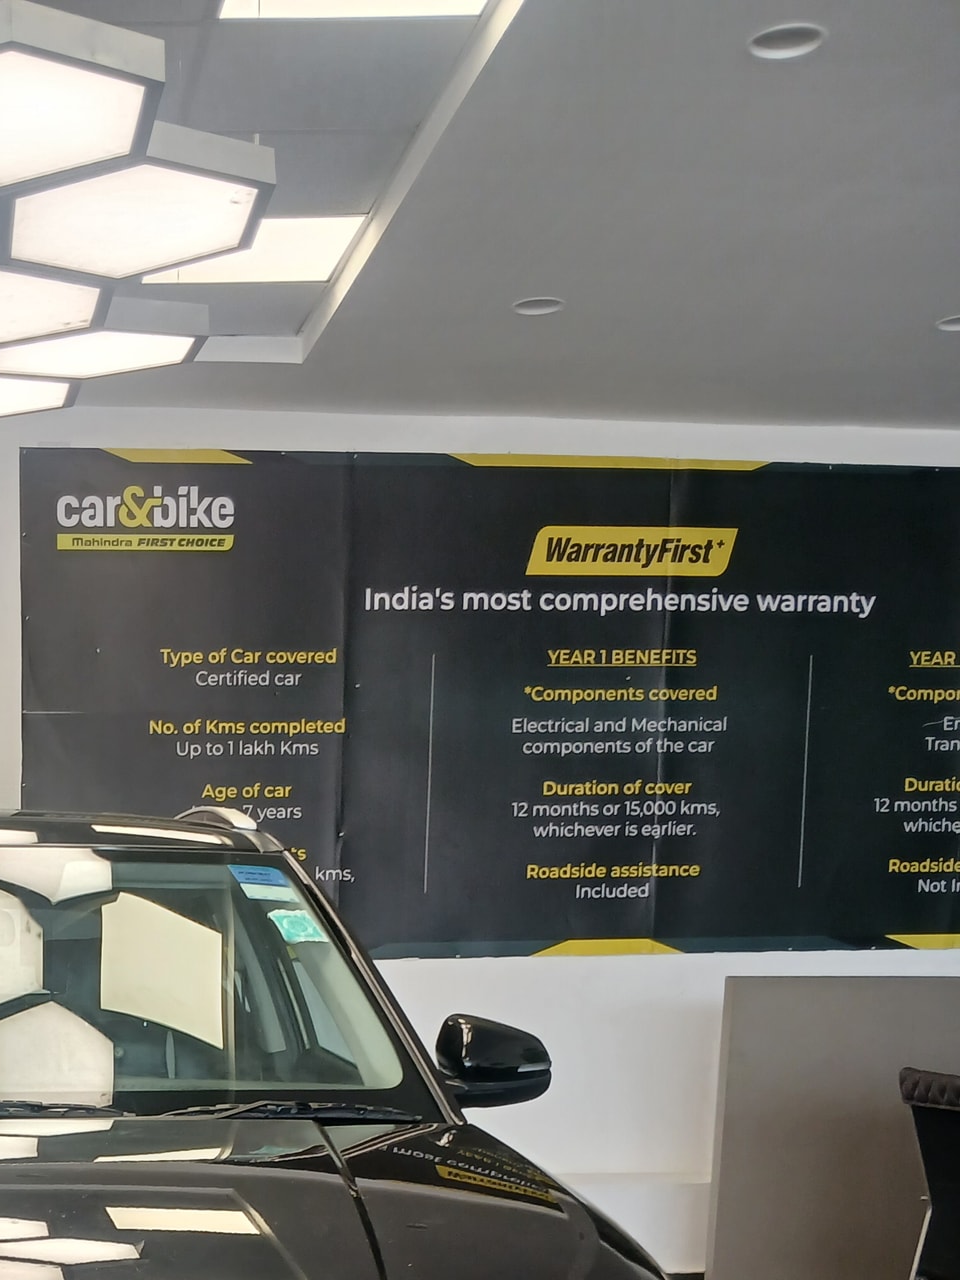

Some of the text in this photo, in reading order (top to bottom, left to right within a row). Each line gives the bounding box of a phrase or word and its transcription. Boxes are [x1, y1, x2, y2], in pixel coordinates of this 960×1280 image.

[56, 485, 235, 529] car&bike
[72, 537, 226, 548] Mahindra FIRST CHOICE
[364, 585, 877, 618] India's most comprehensive warranty
[160, 648, 337, 667] Type of Car covered
[547, 649, 596, 665] YEAR
[612, 649, 697, 665] BENEFITS
[909, 651, 956, 665] YEAR
[195, 670, 302, 686] Certified car
[648, 685, 718, 701] covered
[149, 718, 346, 737] No. of Kms completed
[511, 716, 728, 733] Electrical and Mechanical
[176, 741, 202, 759] Up
[206, 742, 224, 756] to
[239, 740, 275, 756] lakh
[280, 741, 319, 756] Kms
[522, 738, 715, 757] components of the car
[201, 783, 292, 801] Age of car
[542, 779, 692, 796] Duration of cover
[511, 800, 721, 818] 12 months or 15,000 kms,
[873, 797, 958, 813] 12 months
[256, 806, 302, 822] years
[533, 820, 697, 839] whichever is earlier.
[526, 862, 701, 879] Roadside assistance
[888, 858, 960, 873] Roadside
[315, 866, 355, 883] kms,
[575, 882, 650, 899] Included
[917, 879, 947, 893] Not
